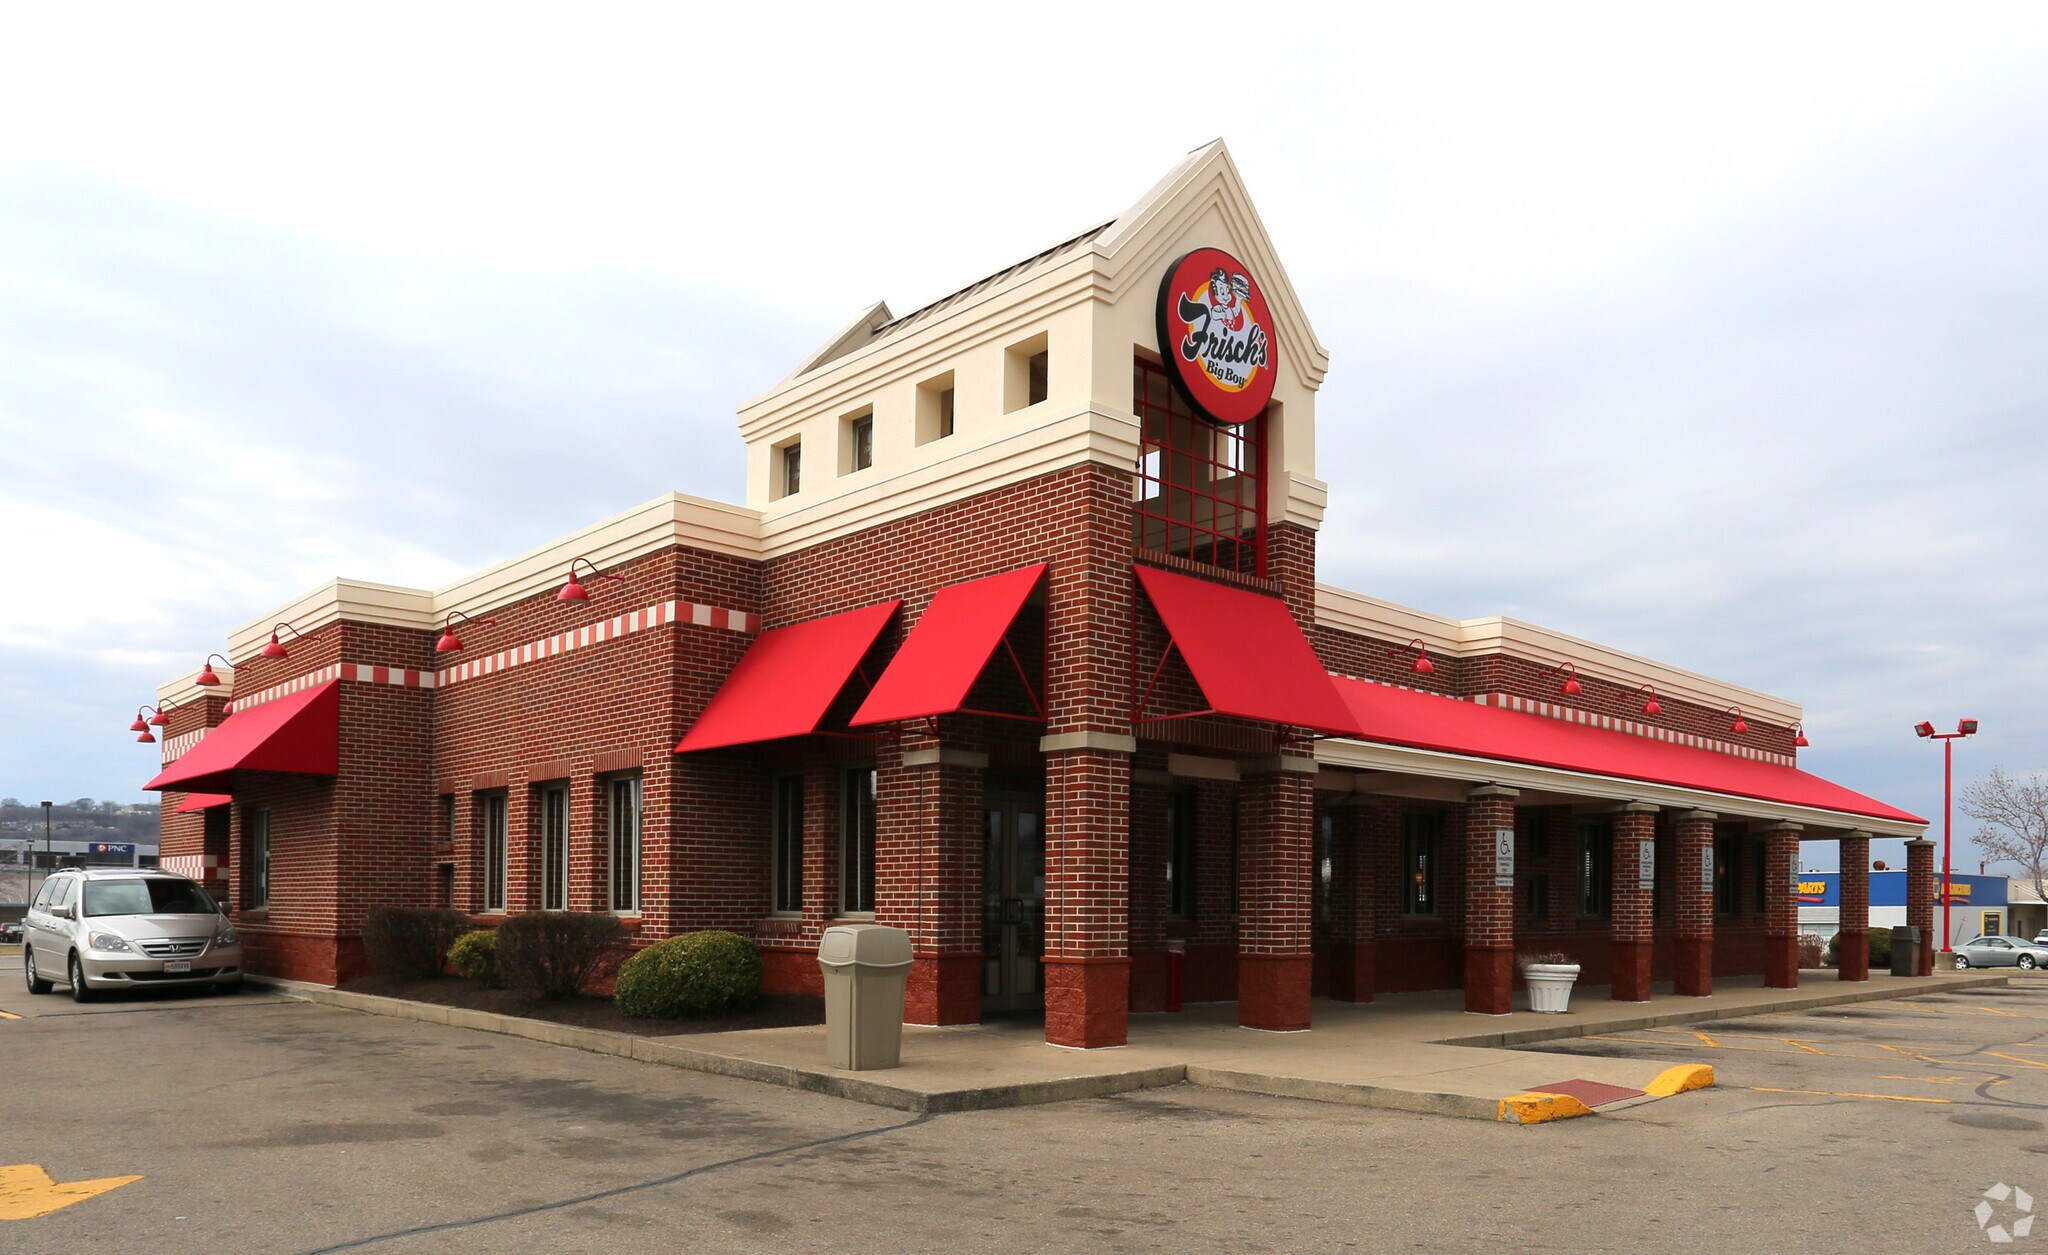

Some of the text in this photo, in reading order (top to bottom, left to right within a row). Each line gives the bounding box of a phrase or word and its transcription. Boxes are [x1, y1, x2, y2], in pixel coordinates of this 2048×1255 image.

[1179, 293, 1267, 367] Frisch's
[1206, 360, 1246, 388] Big Boy
[107, 844, 127, 853] PNC
